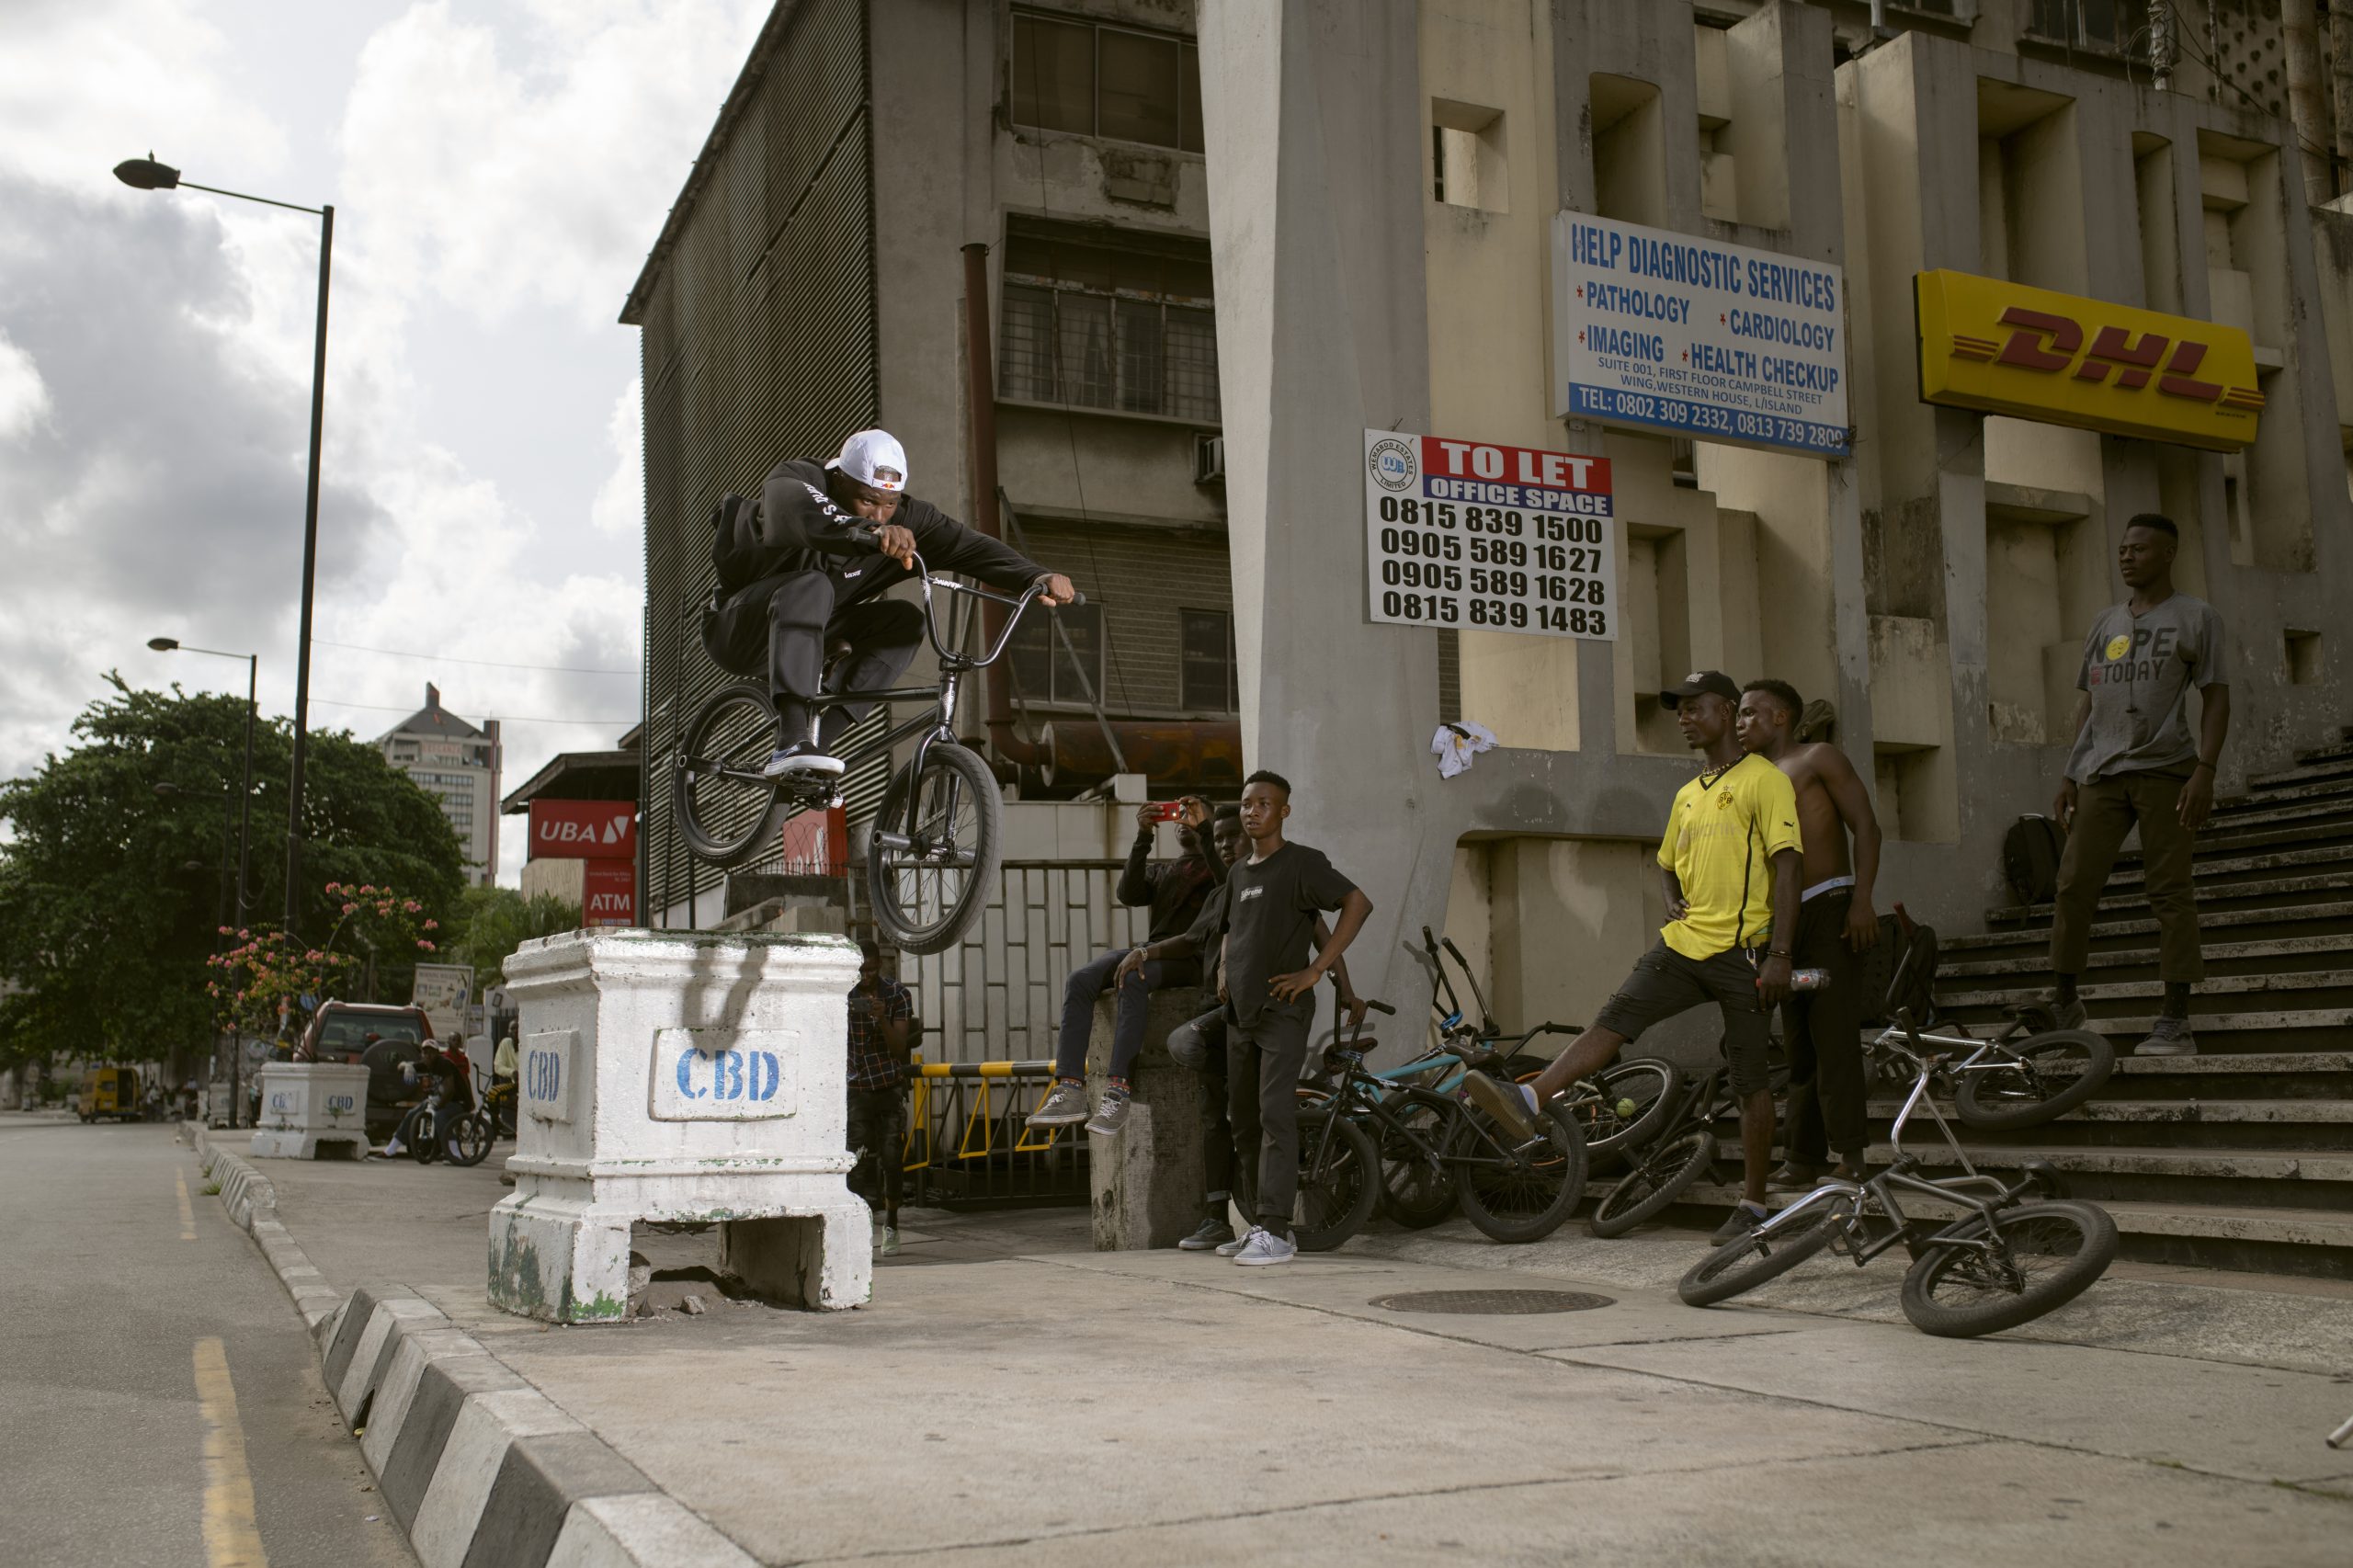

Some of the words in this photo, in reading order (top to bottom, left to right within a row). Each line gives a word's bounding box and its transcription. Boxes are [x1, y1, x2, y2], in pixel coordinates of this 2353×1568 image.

[1572, 223, 1621, 269] HELP
[1629, 235, 1741, 293] DIAGNOSTIC
[1748, 259, 1835, 312] SERVICES
[1587, 280, 1690, 324] PATHOLOGY
[1588, 326, 1665, 362] IMAGING
[1730, 309, 1835, 352] CARDIOLOGY
[1691, 343, 1756, 379] HEALTH
[1762, 356, 1838, 393] CHECKUP
[1995, 306, 2224, 403] DHL
[1598, 357, 1630, 372] SUITE
[1632, 362, 1655, 378] 001,
[1660, 367, 1688, 381] FIRST
[1691, 372, 1726, 389] FLOOR
[1728, 379, 1784, 399] CAMPBELL
[1787, 390, 1823, 405] STREET
[1712, 391, 1753, 409] HOUSE,
[1755, 397, 1802, 415] L/ISLAND
[1578, 386, 1612, 412] TEL:
[1616, 393, 1655, 419] 0802
[1659, 401, 1688, 424] 309
[1691, 405, 1733, 435] 2332,
[1737, 414, 1774, 438] 0813
[1778, 420, 1803, 443] 739
[1808, 425, 1844, 449] 2809
[1371, 442, 1393, 471] WEMABOD
[1395, 444, 1414, 475] ESTATES
[1440, 441, 1505, 480] TO
[1518, 450, 1594, 489] LET
[1380, 478, 1405, 489] LIMITED
[1430, 478, 1519, 506] OFFICE
[1526, 488, 1608, 515] SPACE
[1380, 495, 1457, 529] 0815
[1465, 506, 1523, 537] 839
[1532, 514, 1603, 544] 1500
[1381, 528, 1461, 562] 0905
[1470, 537, 1528, 567] 589
[1533, 544, 1602, 574] 1627
[1382, 559, 1462, 592] 0905
[1470, 567, 1528, 597] 589
[1534, 574, 1605, 606] 1628
[1382, 590, 1459, 623] 0815
[1469, 598, 1528, 628] 839
[1535, 605, 1607, 636] 1483
[2103, 659, 2165, 685] TODAY
[540, 821, 597, 843] UBA
[590, 893, 631, 912] ATM
[528, 1050, 560, 1102] CBD
[676, 1048, 779, 1101] CBD
